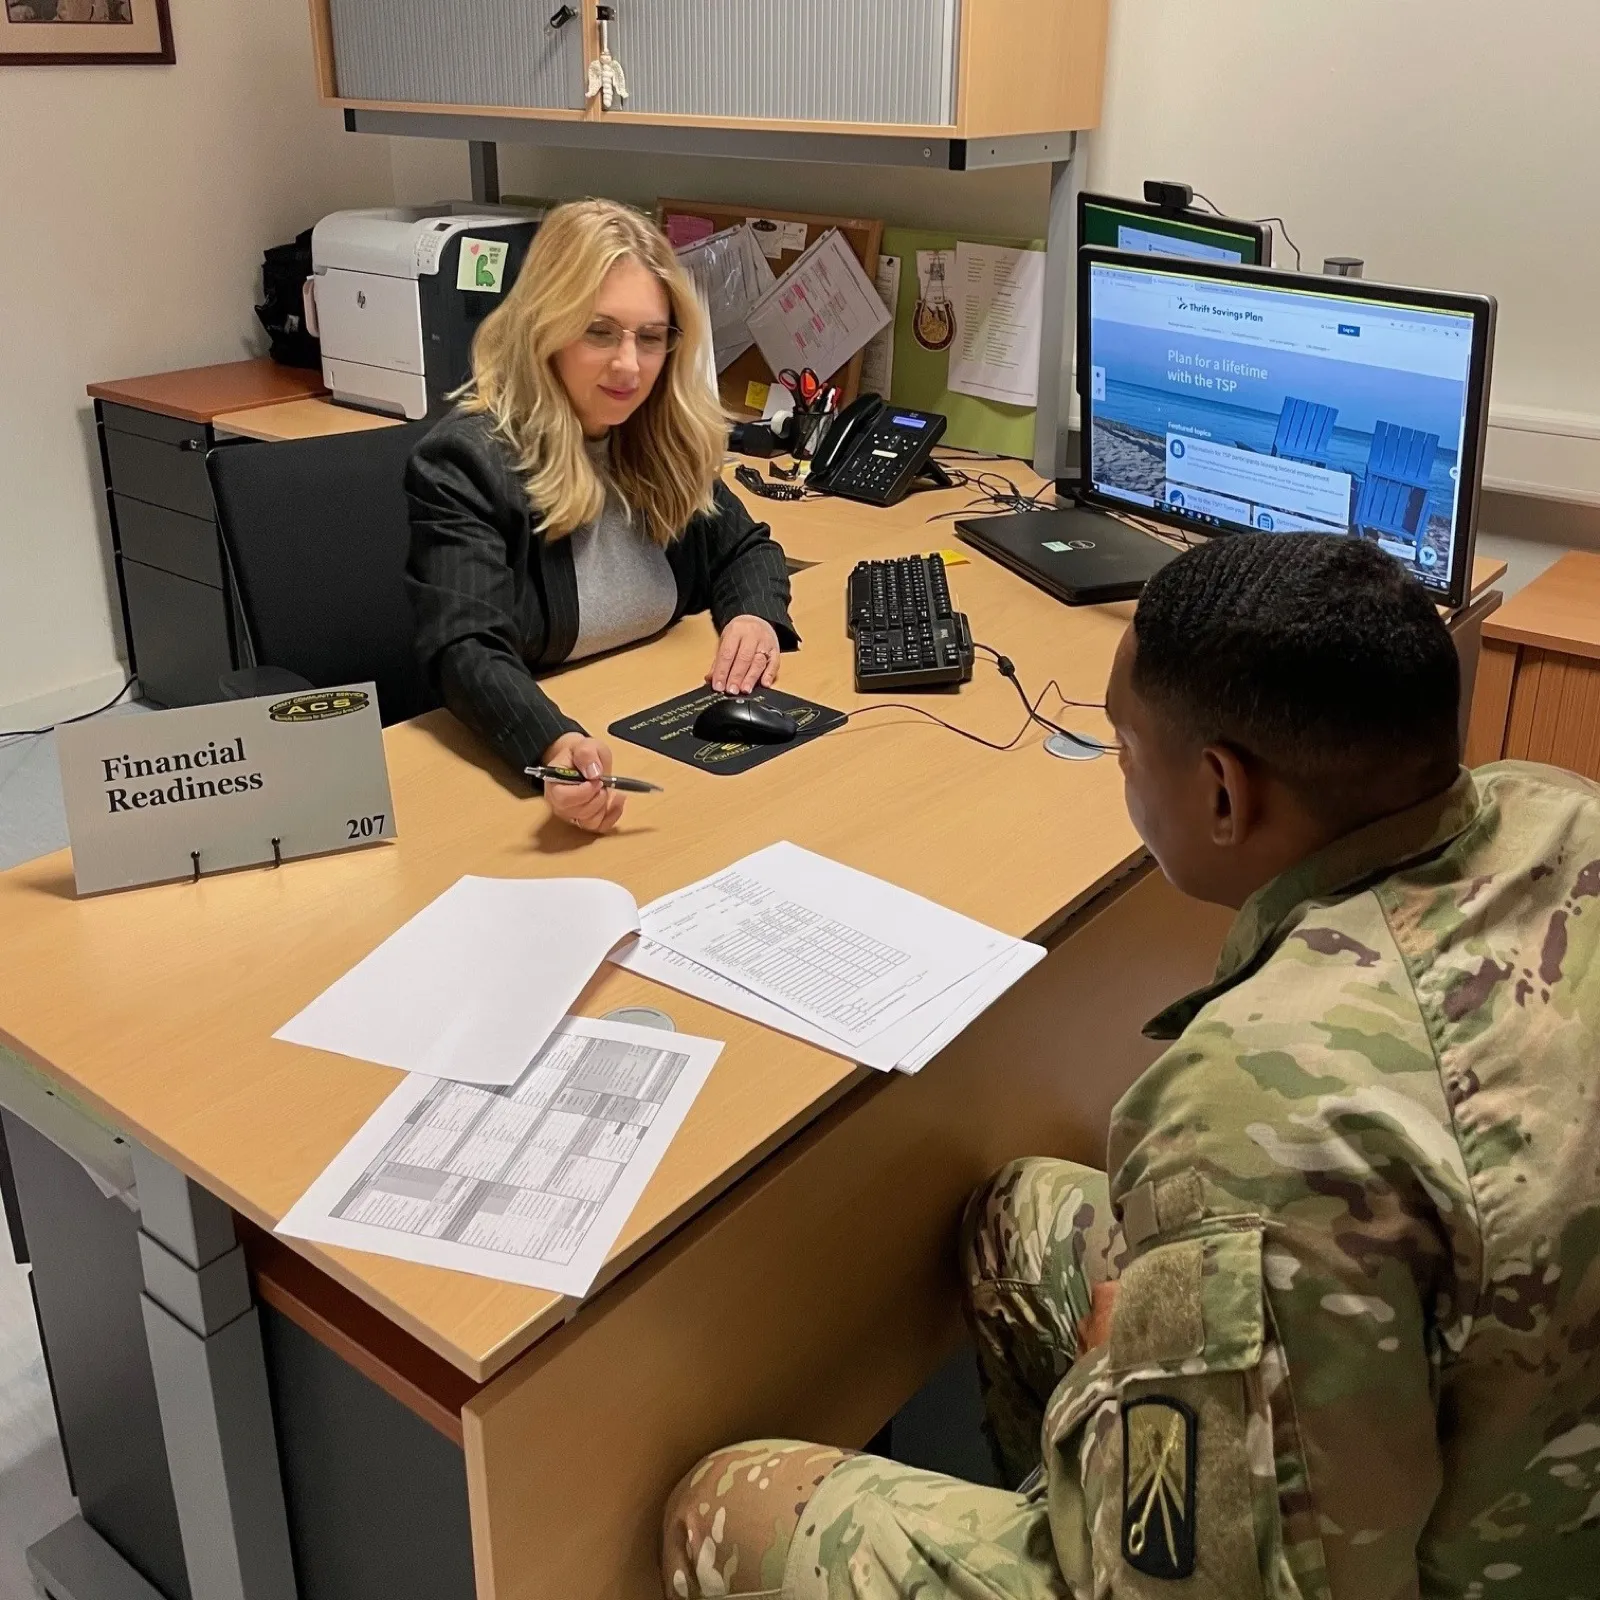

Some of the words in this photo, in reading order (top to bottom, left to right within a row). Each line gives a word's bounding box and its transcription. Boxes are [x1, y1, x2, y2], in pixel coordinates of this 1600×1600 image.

[357, 290, 367, 309] hp
[1189, 303, 1210, 314] Thrift
[1212, 306, 1243, 321] Savings
[1245, 311, 1263, 322] Plan
[1168, 349, 1192, 365] Plan
[1195, 353, 1211, 368] for
[1213, 360, 1220, 371] a
[1222, 359, 1268, 380] lifetime
[1167, 369, 1192, 384] with
[1194, 373, 1213, 388] the
[1215, 377, 1237, 392] TSP
[1168, 421, 1193, 434] Featured
[1194, 426, 1212, 438] topics
[272, 700, 291, 711] ARMY
[293, 692, 334, 704] COMMUNITY
[287, 698, 351, 715] ACS
[101, 737, 247, 783] Financial
[106, 772, 264, 813] Readiness
[346, 814, 385, 839] 207
